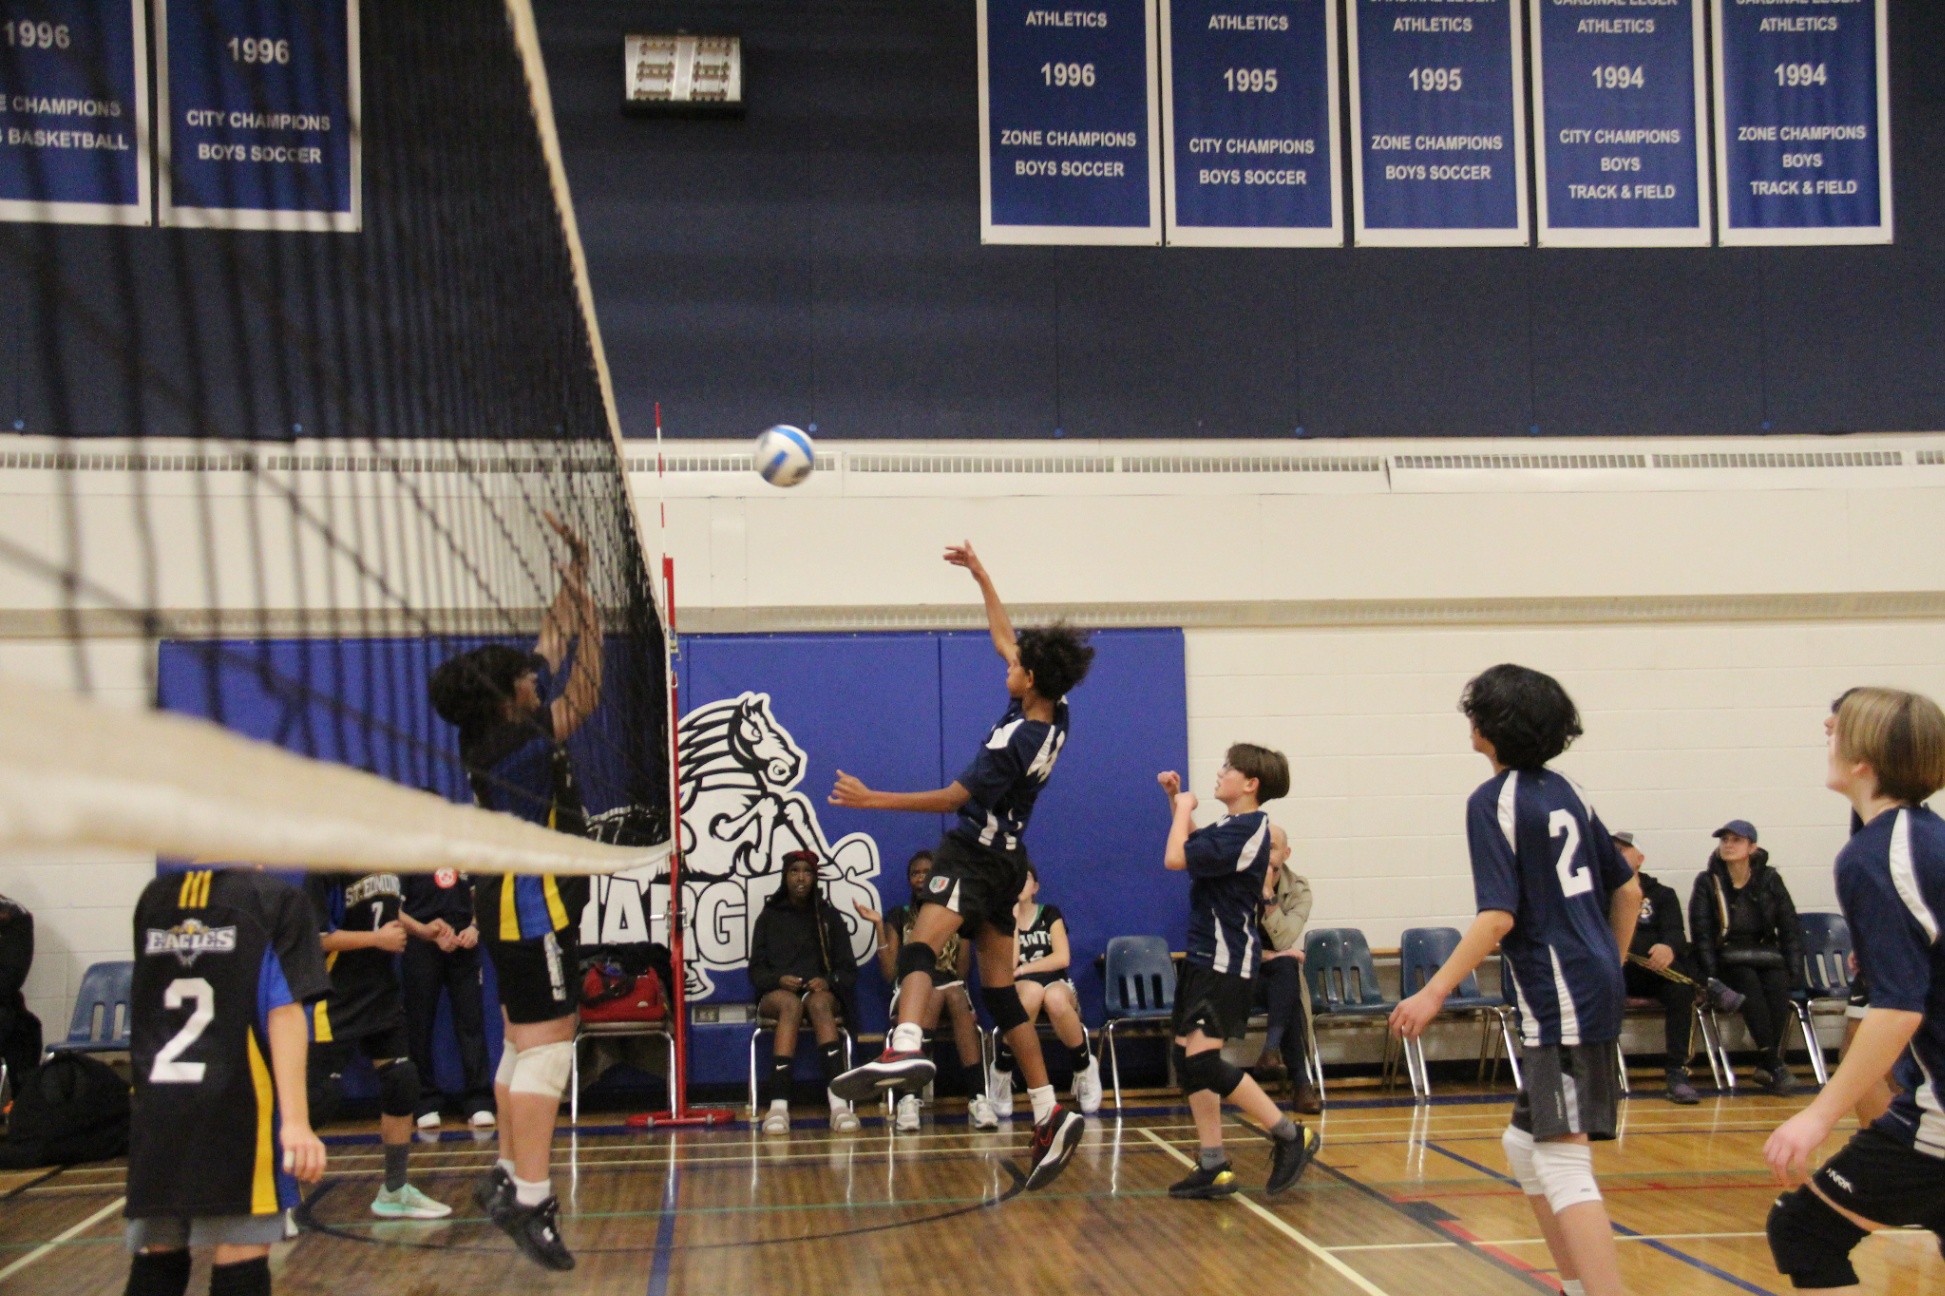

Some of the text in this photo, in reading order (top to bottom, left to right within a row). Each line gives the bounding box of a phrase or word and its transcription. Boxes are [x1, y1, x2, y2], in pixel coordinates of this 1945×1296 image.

[1027, 12, 1108, 29] ATHLETICS
[1209, 16, 1290, 32] ATHLETICS
[1394, 18, 1474, 33] ATHLETICS
[1578, 19, 1656, 34] ATHLETICS
[1761, 18, 1839, 33] ATHLETICS
[4, 21, 71, 49] 1996
[229, 38, 289, 65] 1996
[1041, 64, 1096, 88] 1996
[1224, 69, 1279, 93] 1995
[1409, 69, 1463, 92] 1995
[1592, 67, 1645, 89] 1994
[1775, 64, 1828, 87] 1994
[13, 95, 121, 117] CHAMPIONS
[187, 110, 331, 131] CITY CHAMPIONS
[9, 127, 129, 151] BASKETBALL
[1002, 131, 1137, 148] ZONE CHAMPIONS
[1561, 130, 1682, 144] CITY CHAMPIONS
[1739, 126, 1867, 142] ZONE CHAMPIONS
[1190, 139, 1316, 155] CITY CHAMPIONS
[1373, 136, 1504, 151] ZONE CHAMPIONS
[199, 144, 322, 164] BOYS SOCCER
[1784, 154, 1824, 169] BOYS
[1016, 161, 1125, 178] BOYS SOCCER
[1387, 166, 1492, 181] BOYS SOCCER
[1602, 158, 1642, 172] BOYS
[1200, 170, 1307, 186] BOYS SOCCER
[1570, 185, 1677, 200] TRACK & FIELD
[1752, 181, 1859, 196] TRACK & FIELD
[1548, 808, 1594, 898] 2
[371, 901, 383, 931] 7
[146, 926, 236, 954] EAGLES
[149, 978, 214, 1083] 2
